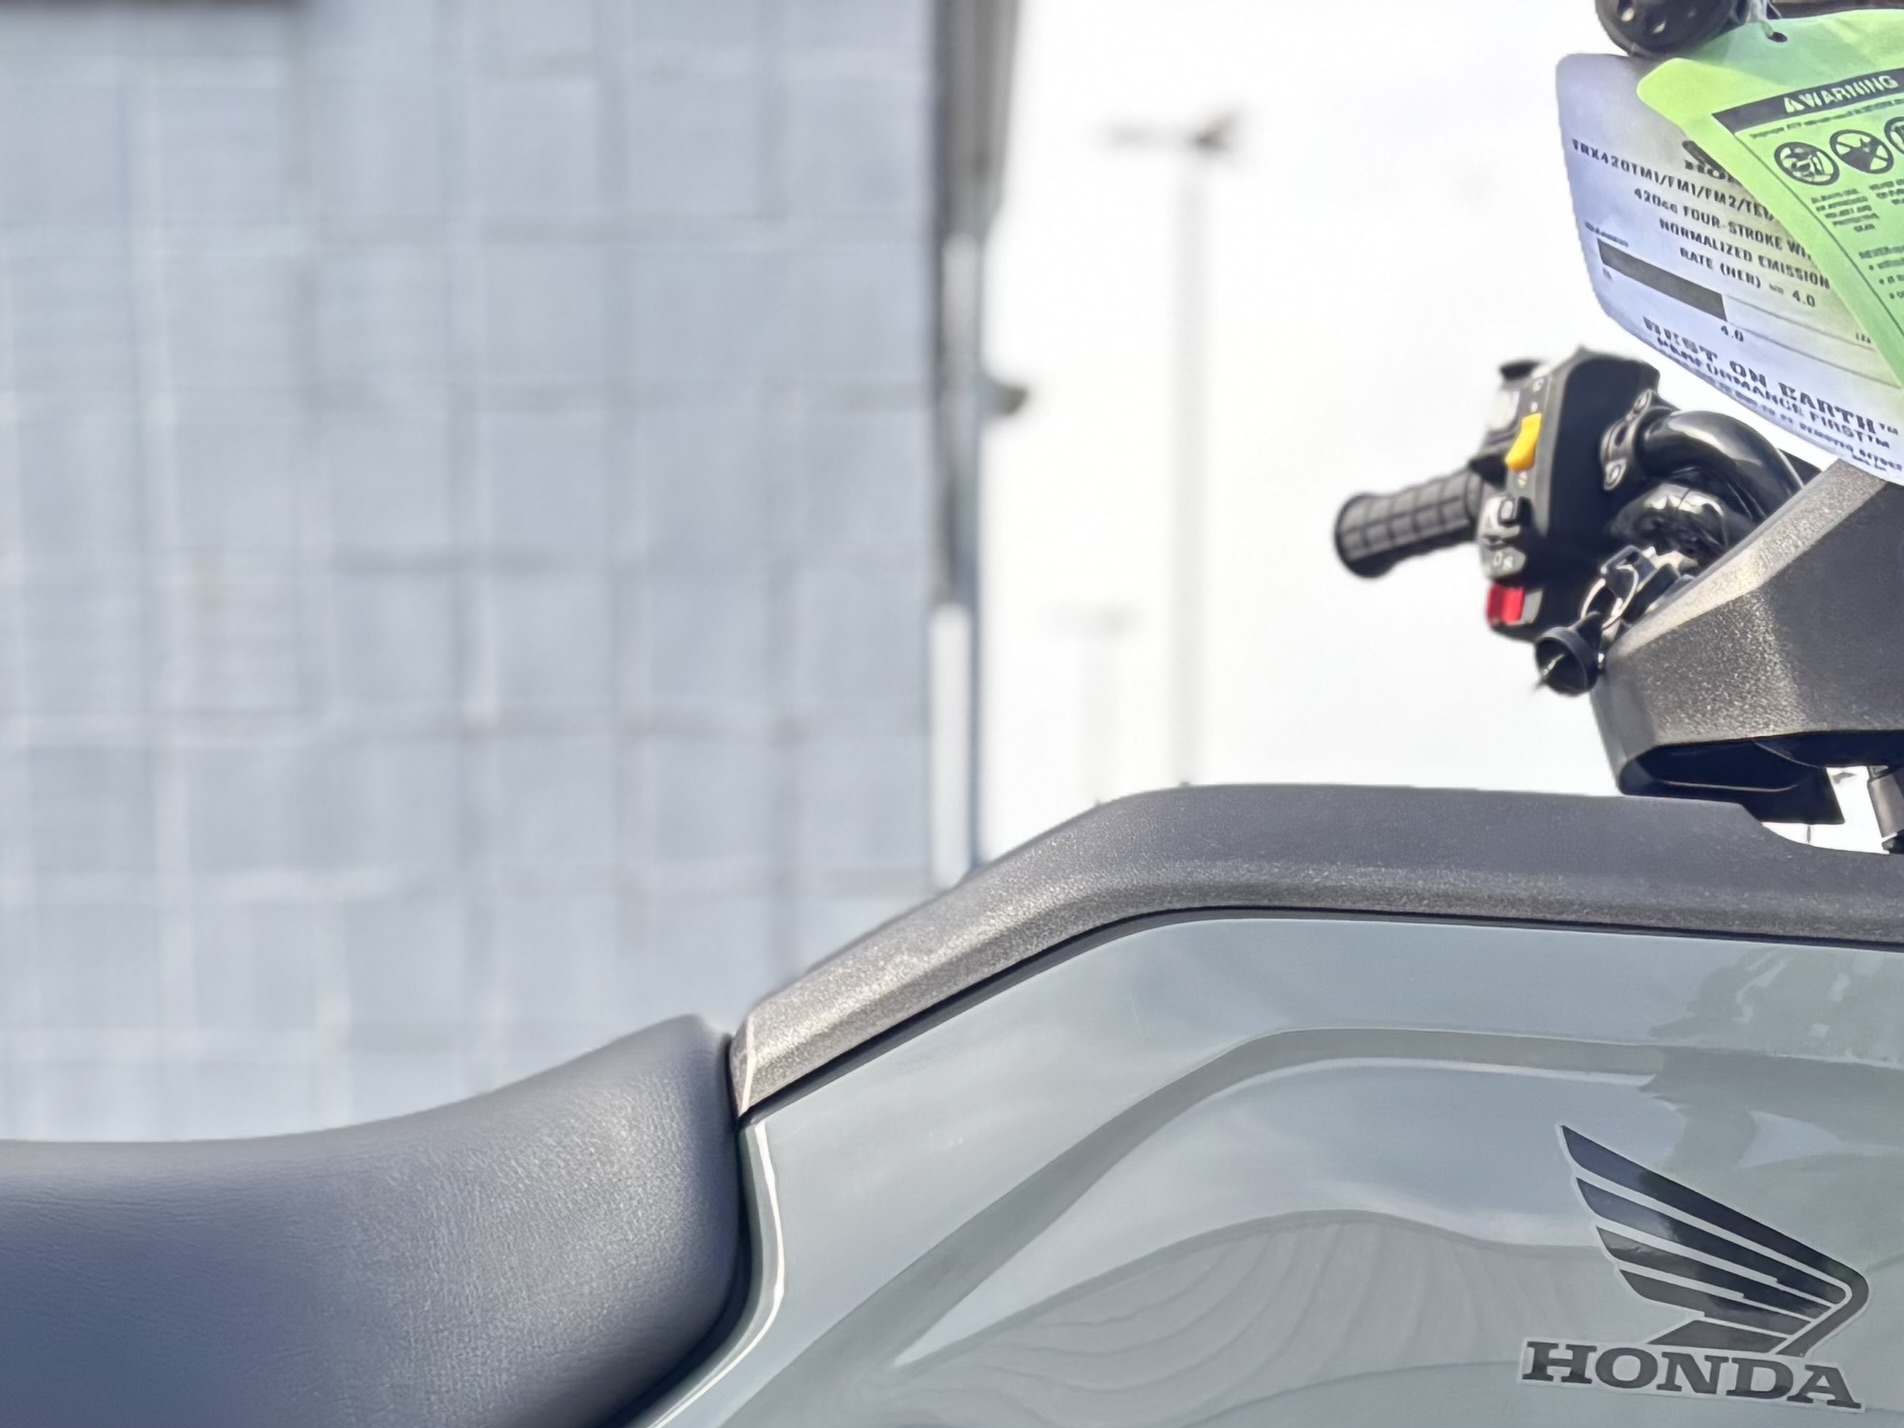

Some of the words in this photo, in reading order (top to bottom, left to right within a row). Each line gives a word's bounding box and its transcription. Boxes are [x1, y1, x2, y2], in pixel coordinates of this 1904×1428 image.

[1804, 75, 1899, 110] WARNING
[1659, 218, 1752, 262] NORMALIZED
[1680, 247, 1713, 270] RATE
[1791, 289, 1816, 307] 4.0
[1720, 324, 1744, 343] 4.0
[1729, 360, 1767, 388] ON
[1525, 1340, 1862, 1411] HONDA
